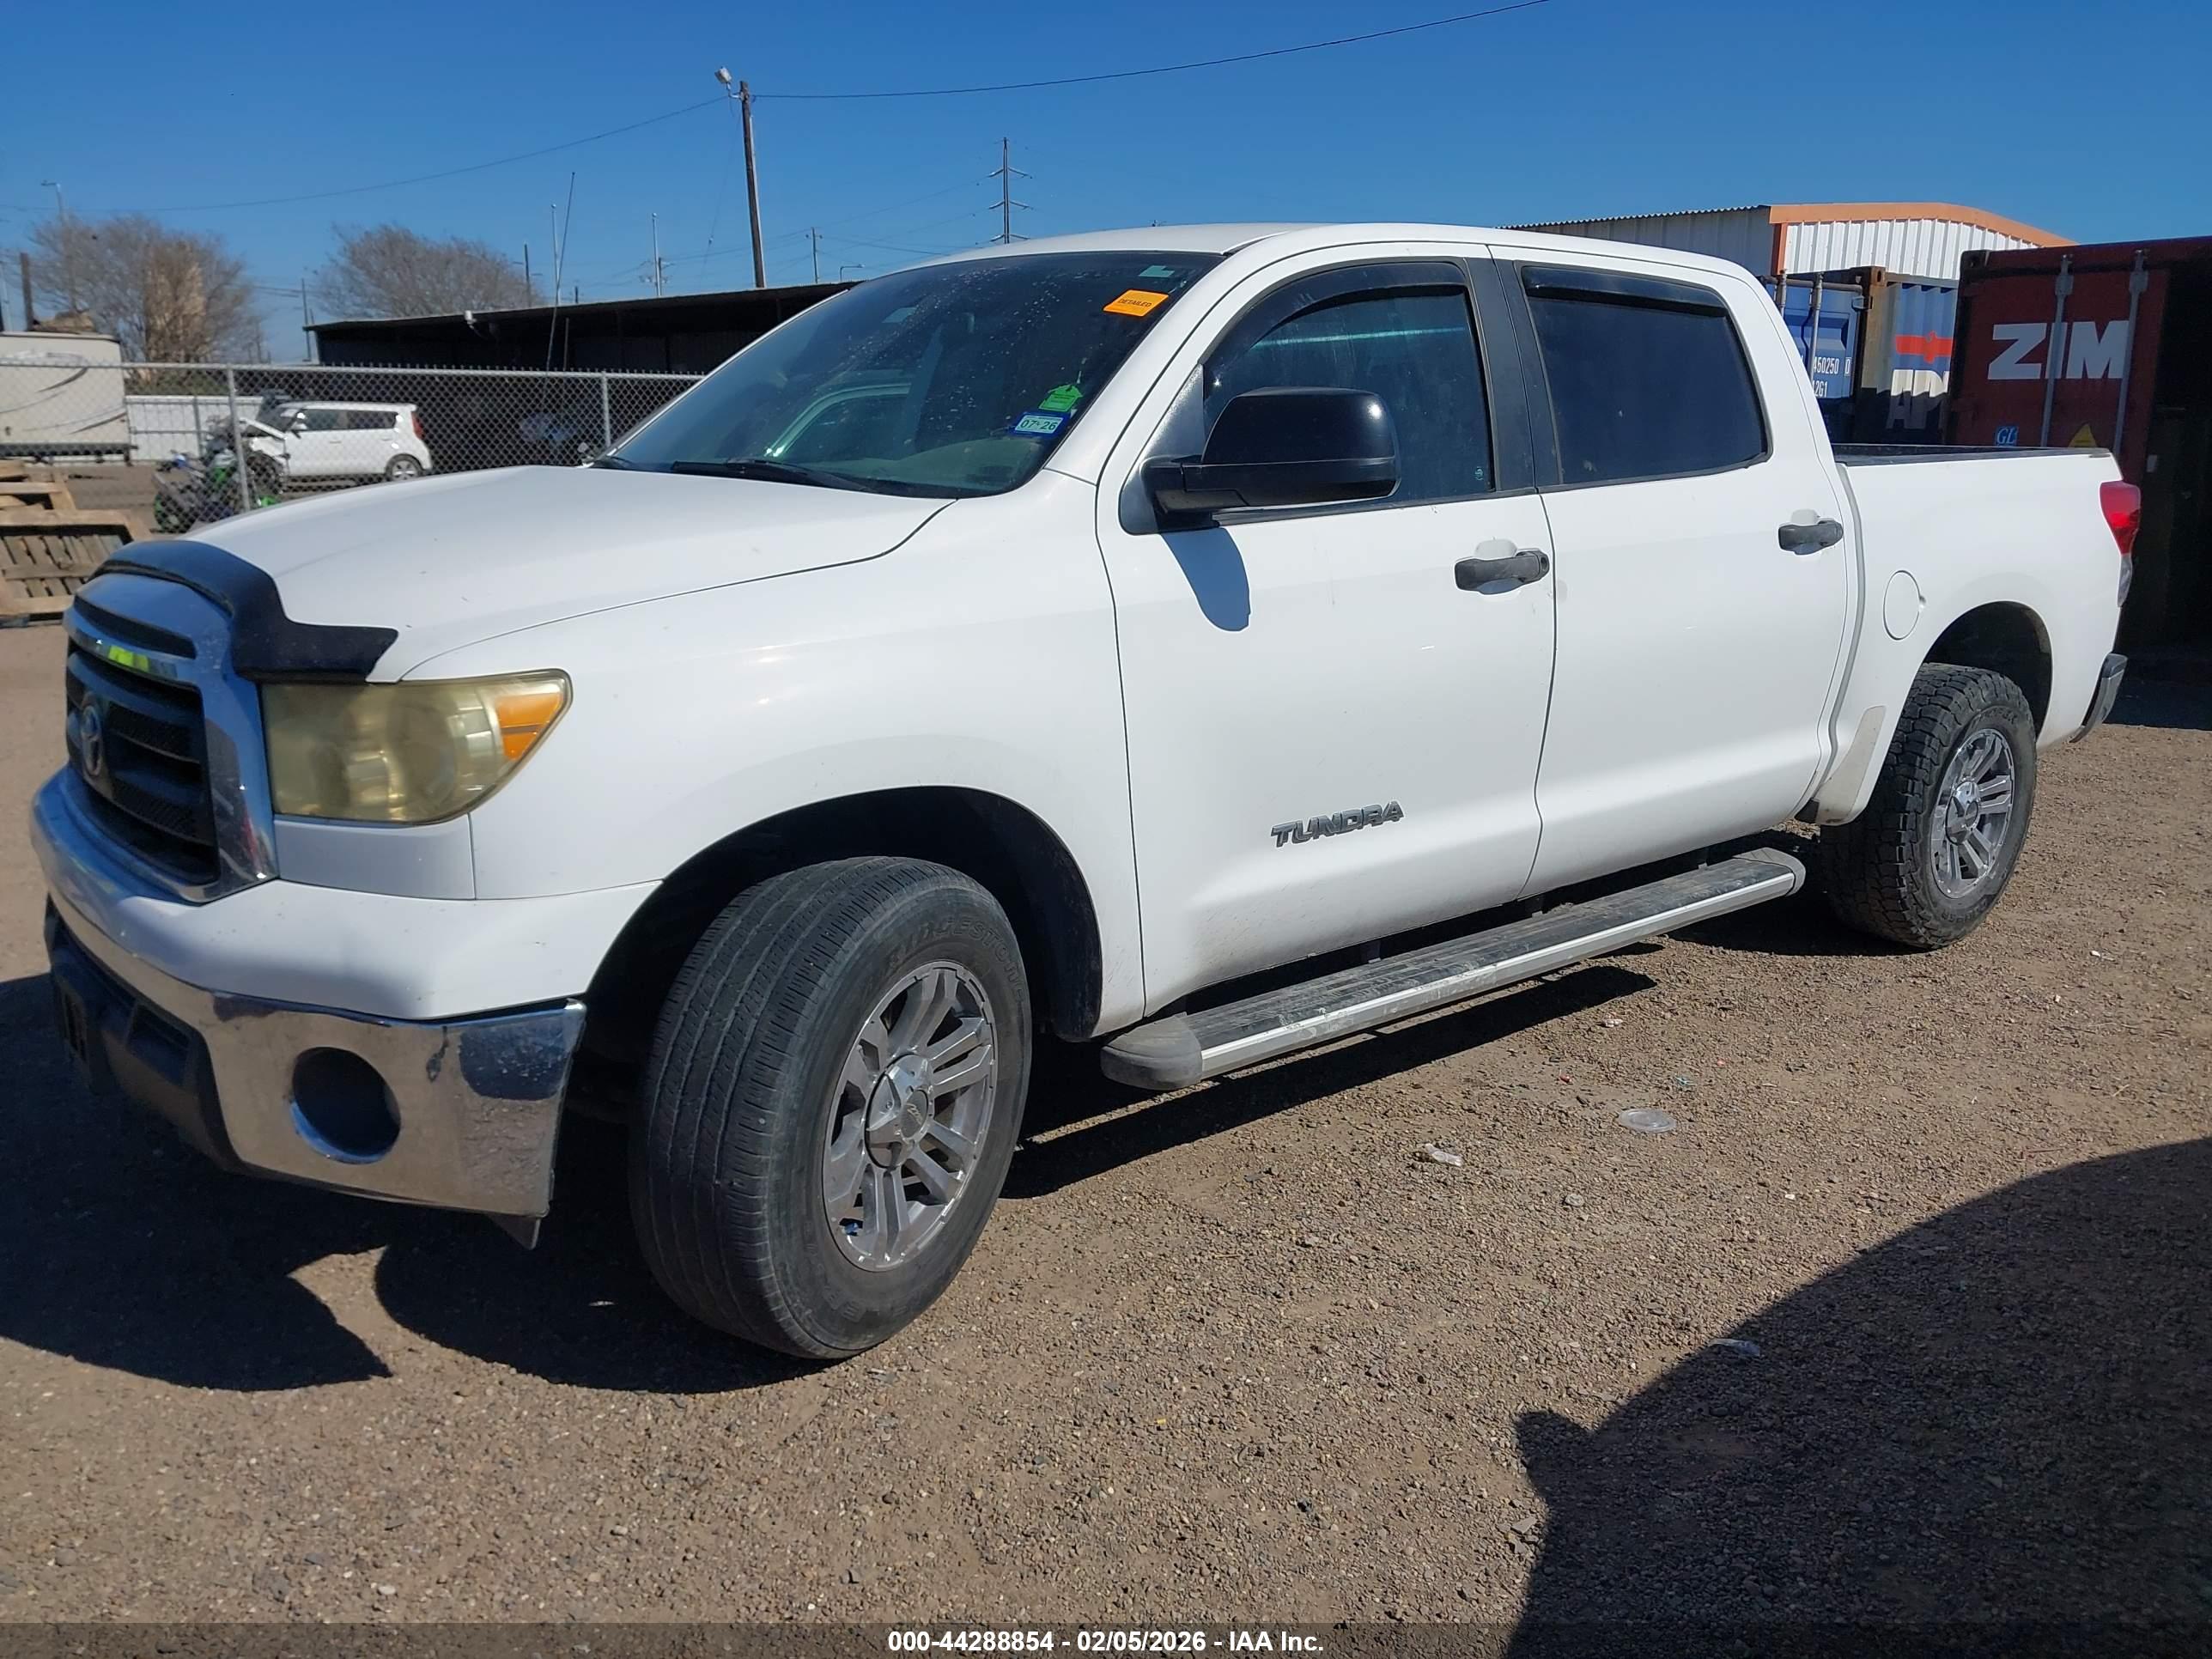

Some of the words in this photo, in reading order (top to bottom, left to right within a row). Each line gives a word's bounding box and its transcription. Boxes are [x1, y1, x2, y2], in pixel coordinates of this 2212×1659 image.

[1987, 320, 2130, 380] ZIM
[1020, 420, 1036, 428] 07
[1040, 421, 1058, 430] 26
[1996, 427, 2017, 445] GL
[1270, 800, 1405, 848] TUNDRA
[887, 915, 1026, 1002] IDGESTONE
